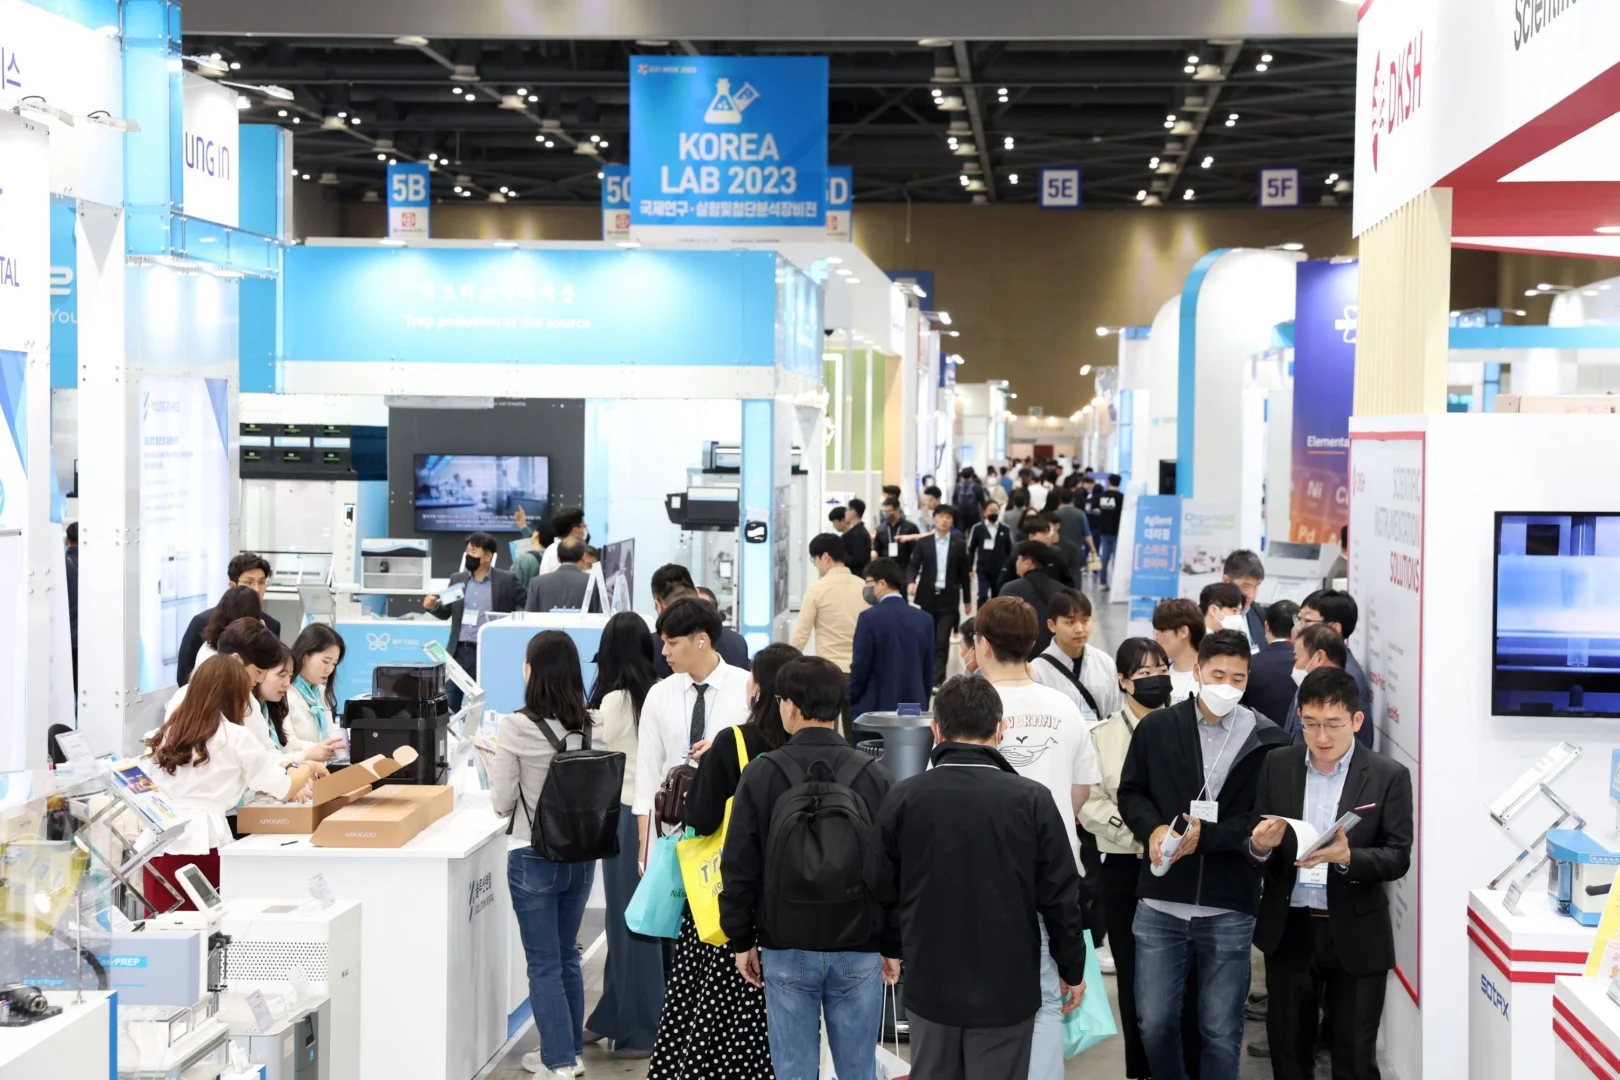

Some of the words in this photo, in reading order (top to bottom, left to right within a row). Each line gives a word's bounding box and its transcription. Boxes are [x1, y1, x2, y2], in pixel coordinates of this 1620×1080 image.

[1388, 30, 1423, 135] DKSH
[679, 132, 780, 161] KOREA
[392, 174, 426, 202] 5B
[660, 165, 720, 194] LAB
[727, 166, 797, 194] 2023
[1047, 178, 1073, 198] 5E
[1267, 178, 1294, 198] 5F
[438, 314, 499, 330] pollution
[504, 316, 517, 328] at
[521, 315, 542, 328] the
[546, 318, 590, 329] source
[1389, 551, 1420, 593] SOLUTIONS
